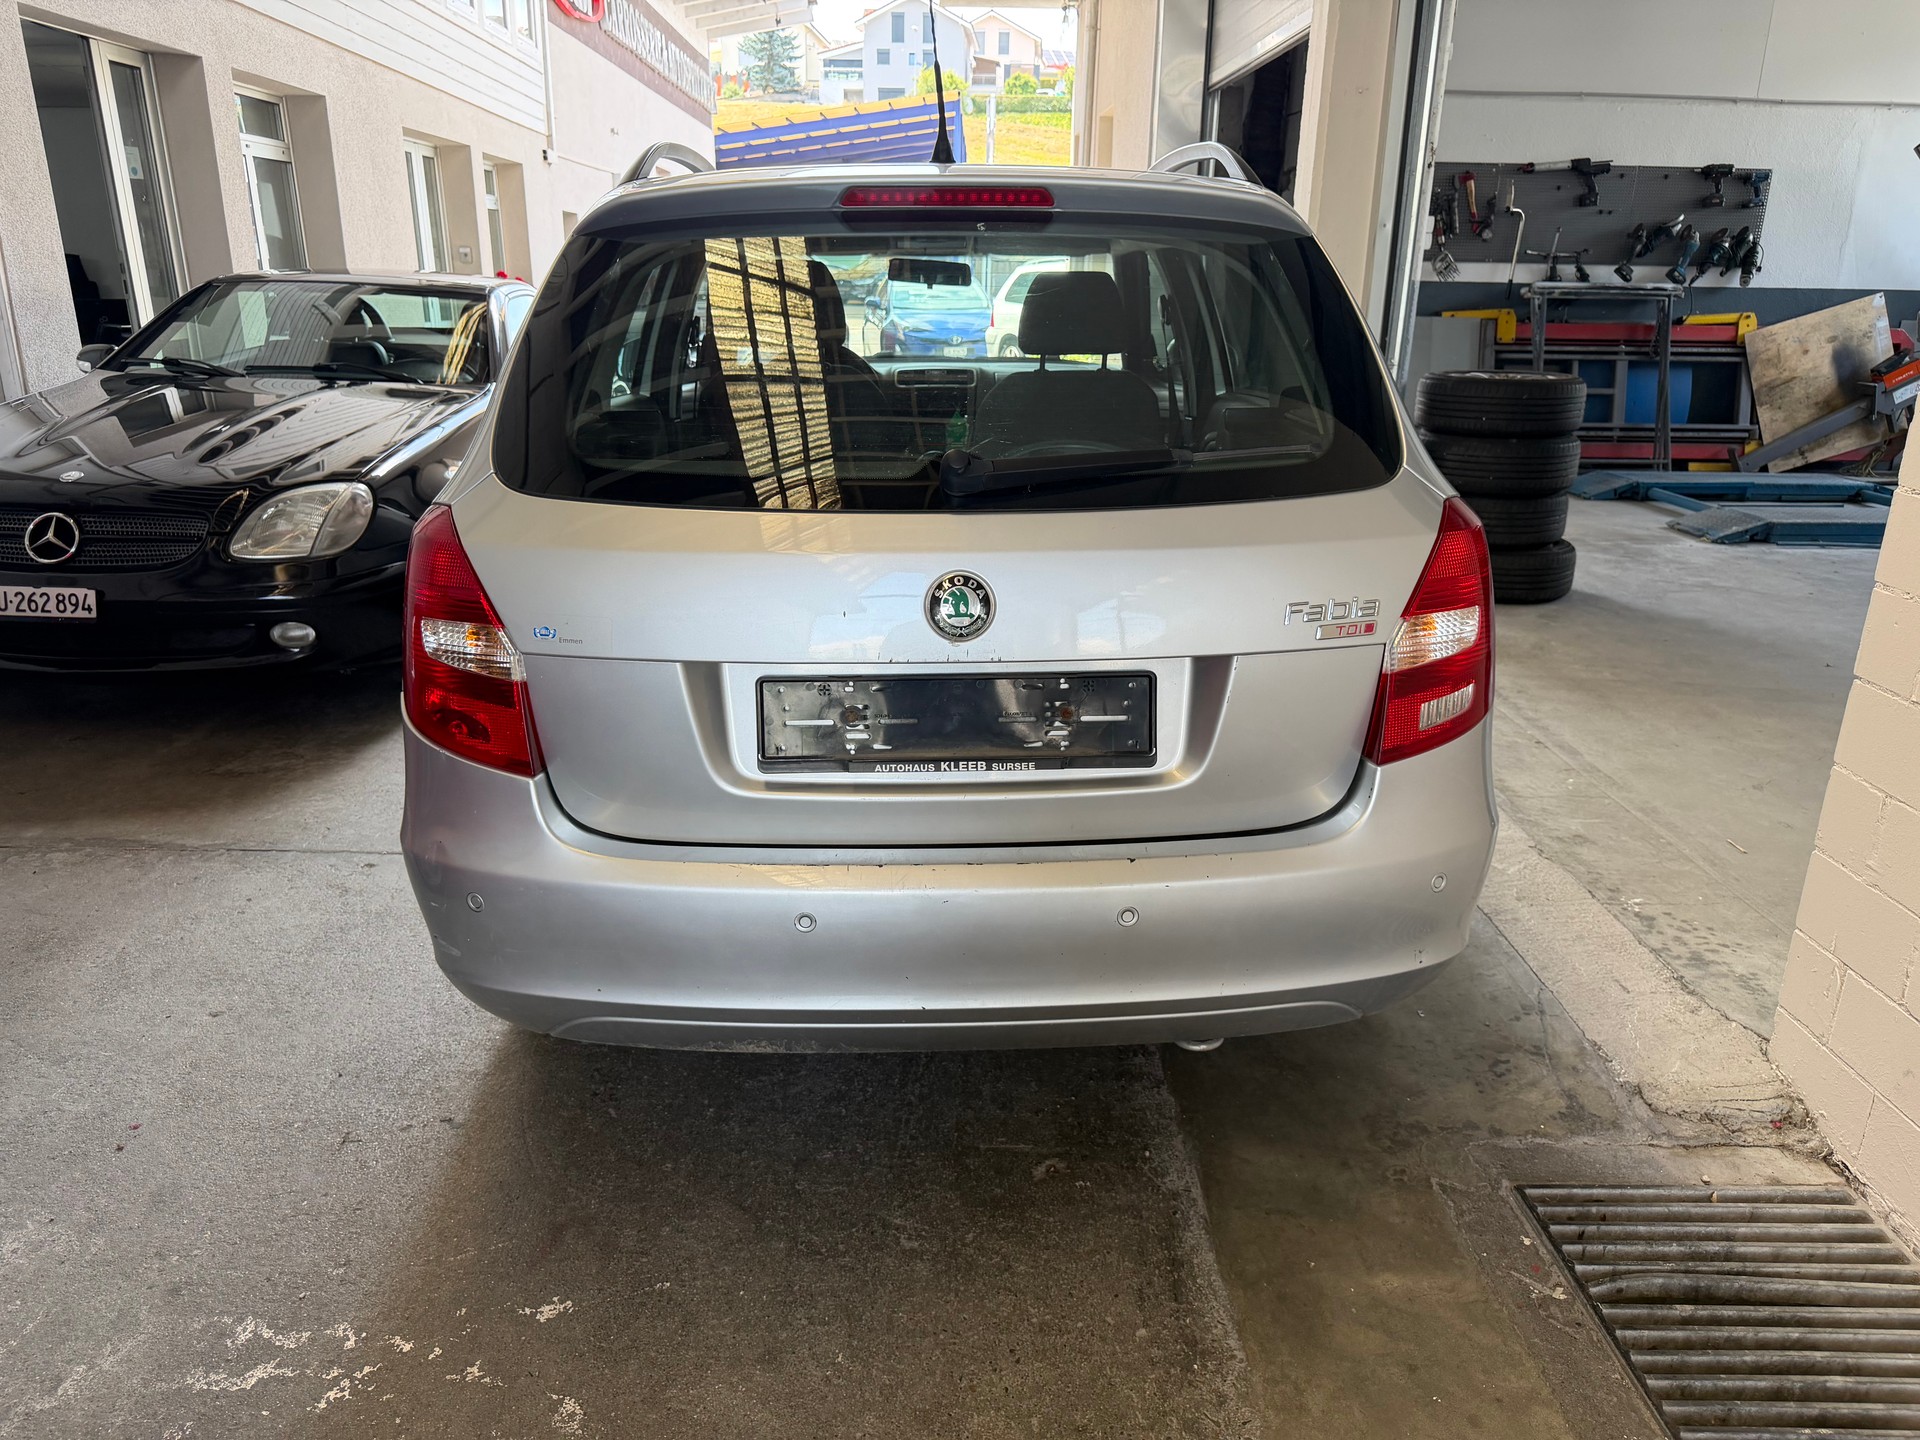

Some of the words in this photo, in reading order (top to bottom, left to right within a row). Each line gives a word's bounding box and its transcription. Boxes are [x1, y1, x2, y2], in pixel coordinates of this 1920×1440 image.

[55, 593, 93, 614] 894
[1284, 597, 1380, 625] Fabia
[1336, 623, 1363, 636] TDI
[558, 636, 583, 645] Emmen
[874, 763, 935, 772] AUTOHAUS
[940, 761, 987, 771] KLEEB
[991, 762, 1036, 771] SURSEE
